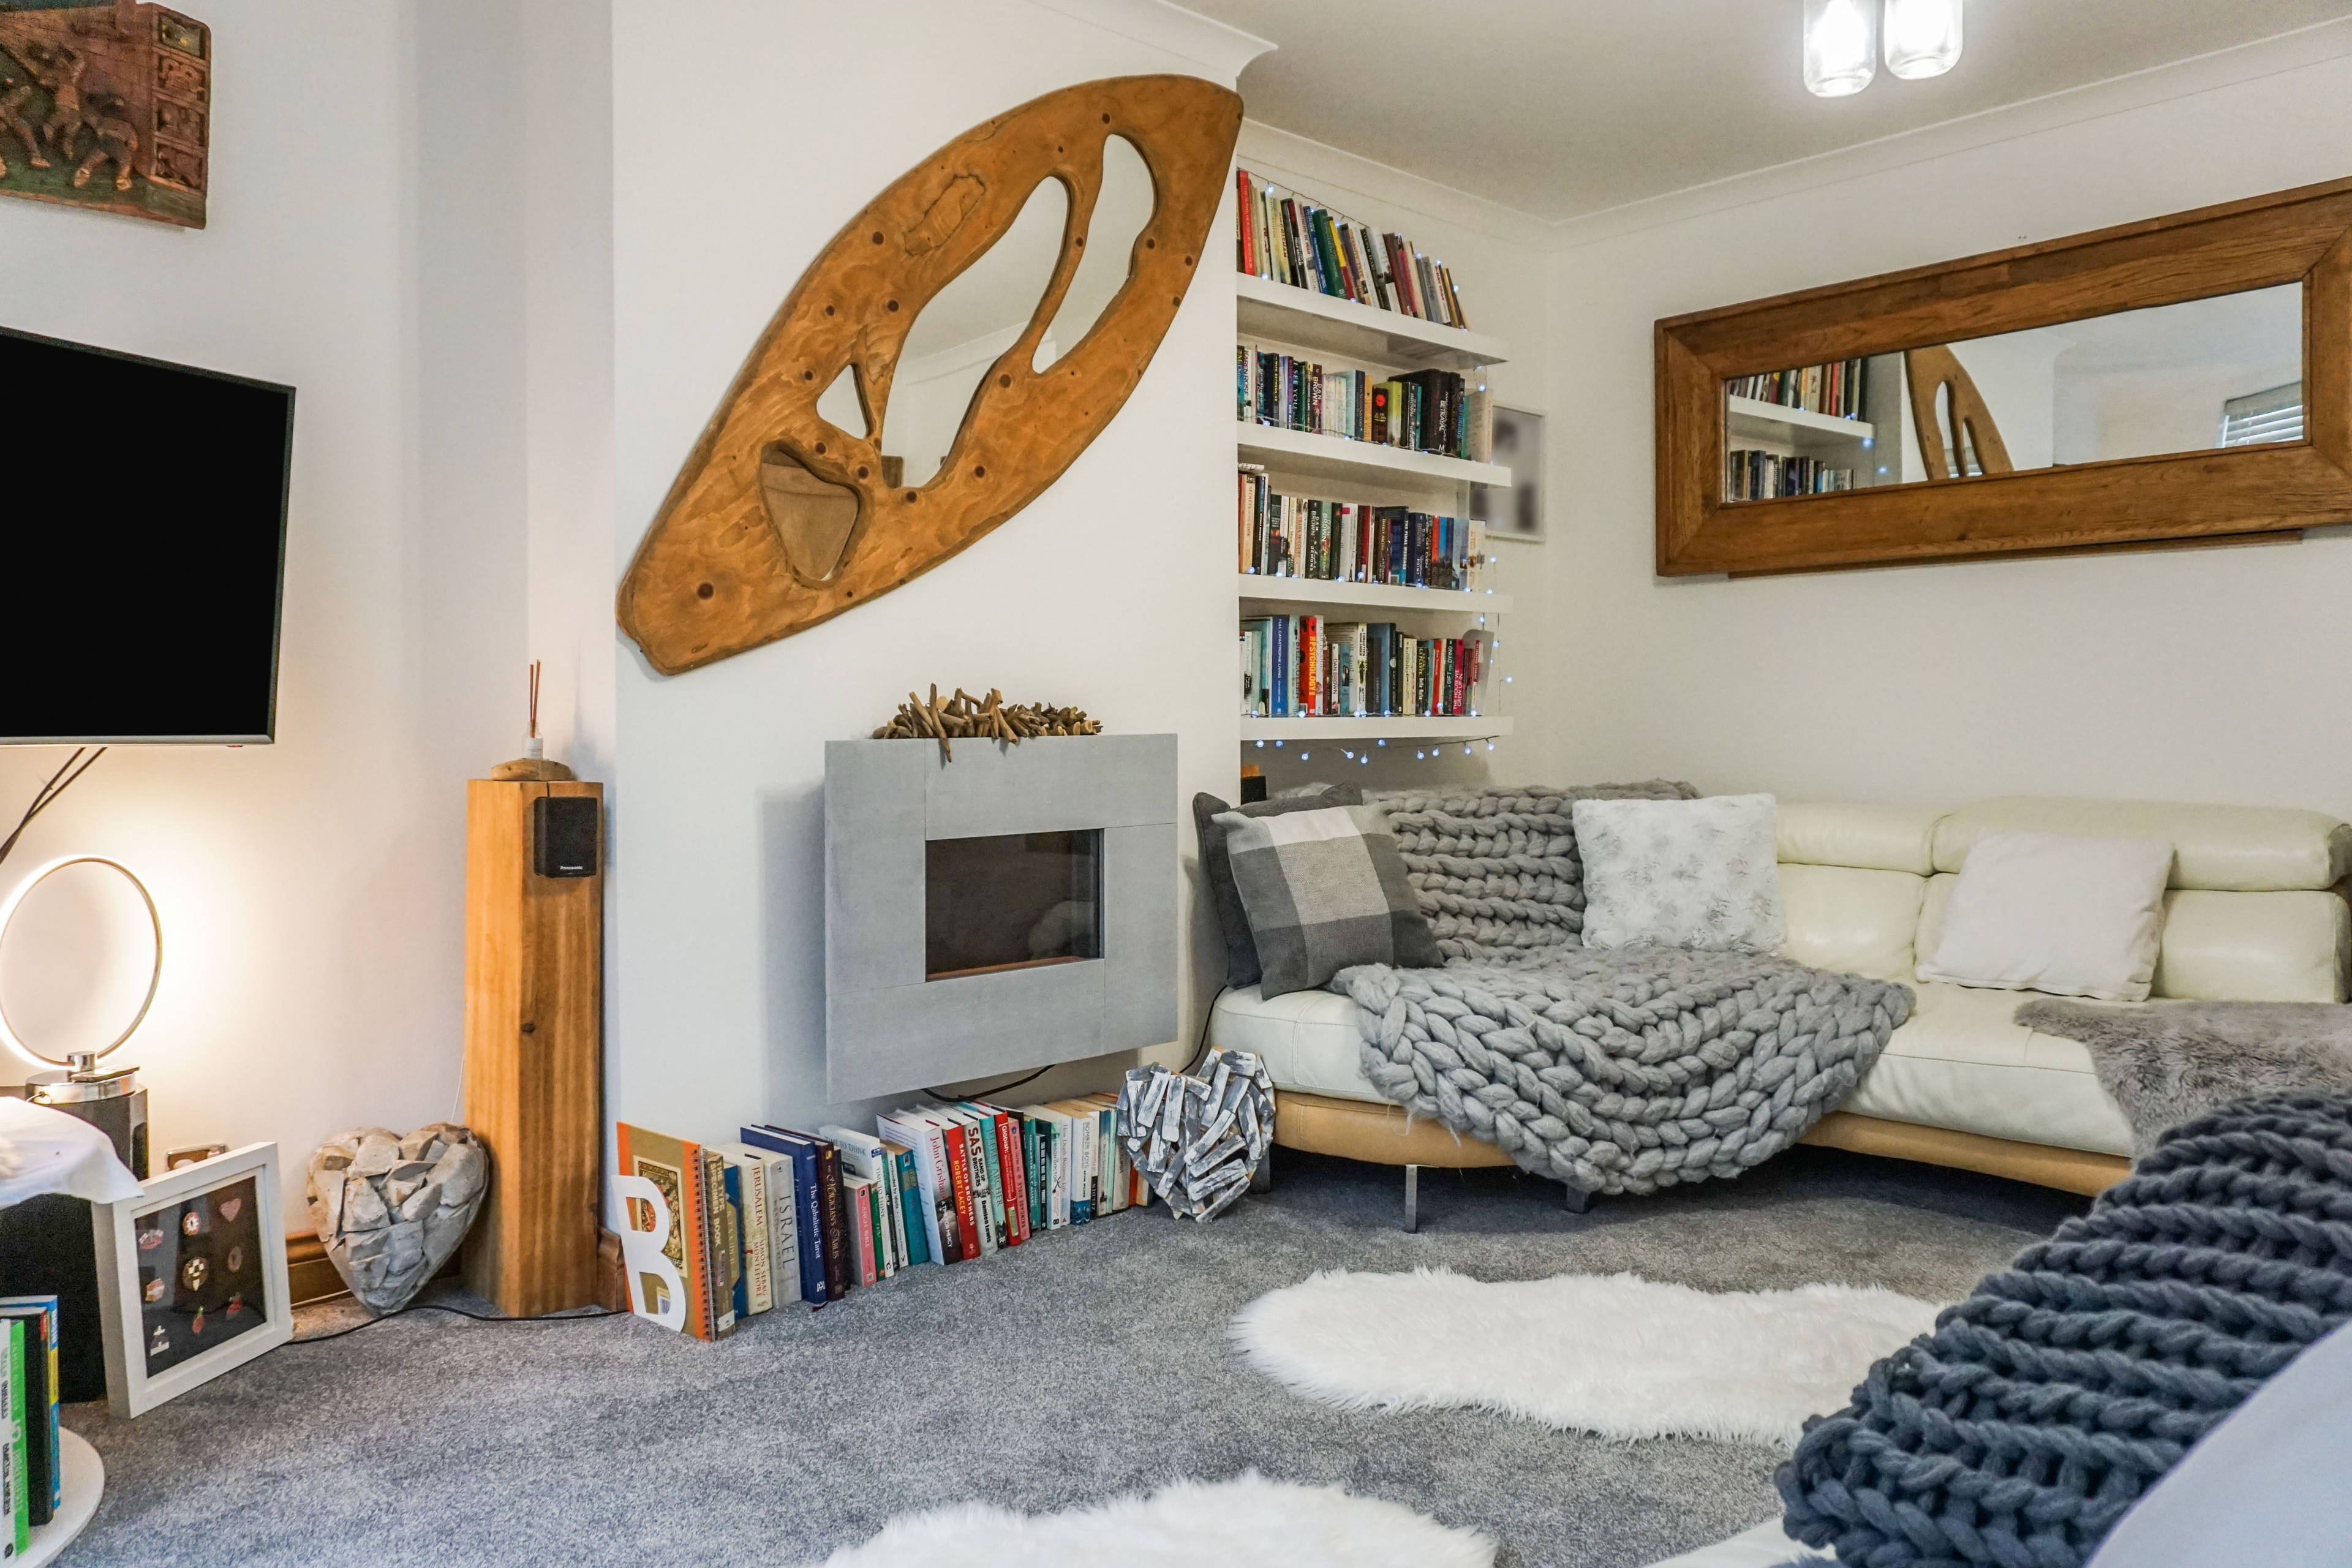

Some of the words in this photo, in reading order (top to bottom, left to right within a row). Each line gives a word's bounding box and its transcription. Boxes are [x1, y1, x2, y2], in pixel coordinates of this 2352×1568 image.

[1455, 669, 1459, 679] WE
[848, 1144, 866, 1156] THINK
[968, 1126, 982, 1156] SAS
[930, 1136, 940, 1159] John
[936, 1160, 947, 1199] Grisham
[959, 1144, 968, 1172] BATTLE
[986, 1128, 998, 1165] JEFFREY
[993, 1167, 1003, 1207] ARCHER
[954, 1160, 963, 1189] ROBERT
[963, 1174, 969, 1183] OF
[753, 1166, 763, 1226] JERUSALEM
[957, 1191, 967, 1216] LACEY
[965, 1185, 975, 1226] BROTHERS
[779, 1196, 795, 1268] ISRAEL
[812, 1200, 820, 1238] Qabalistic
